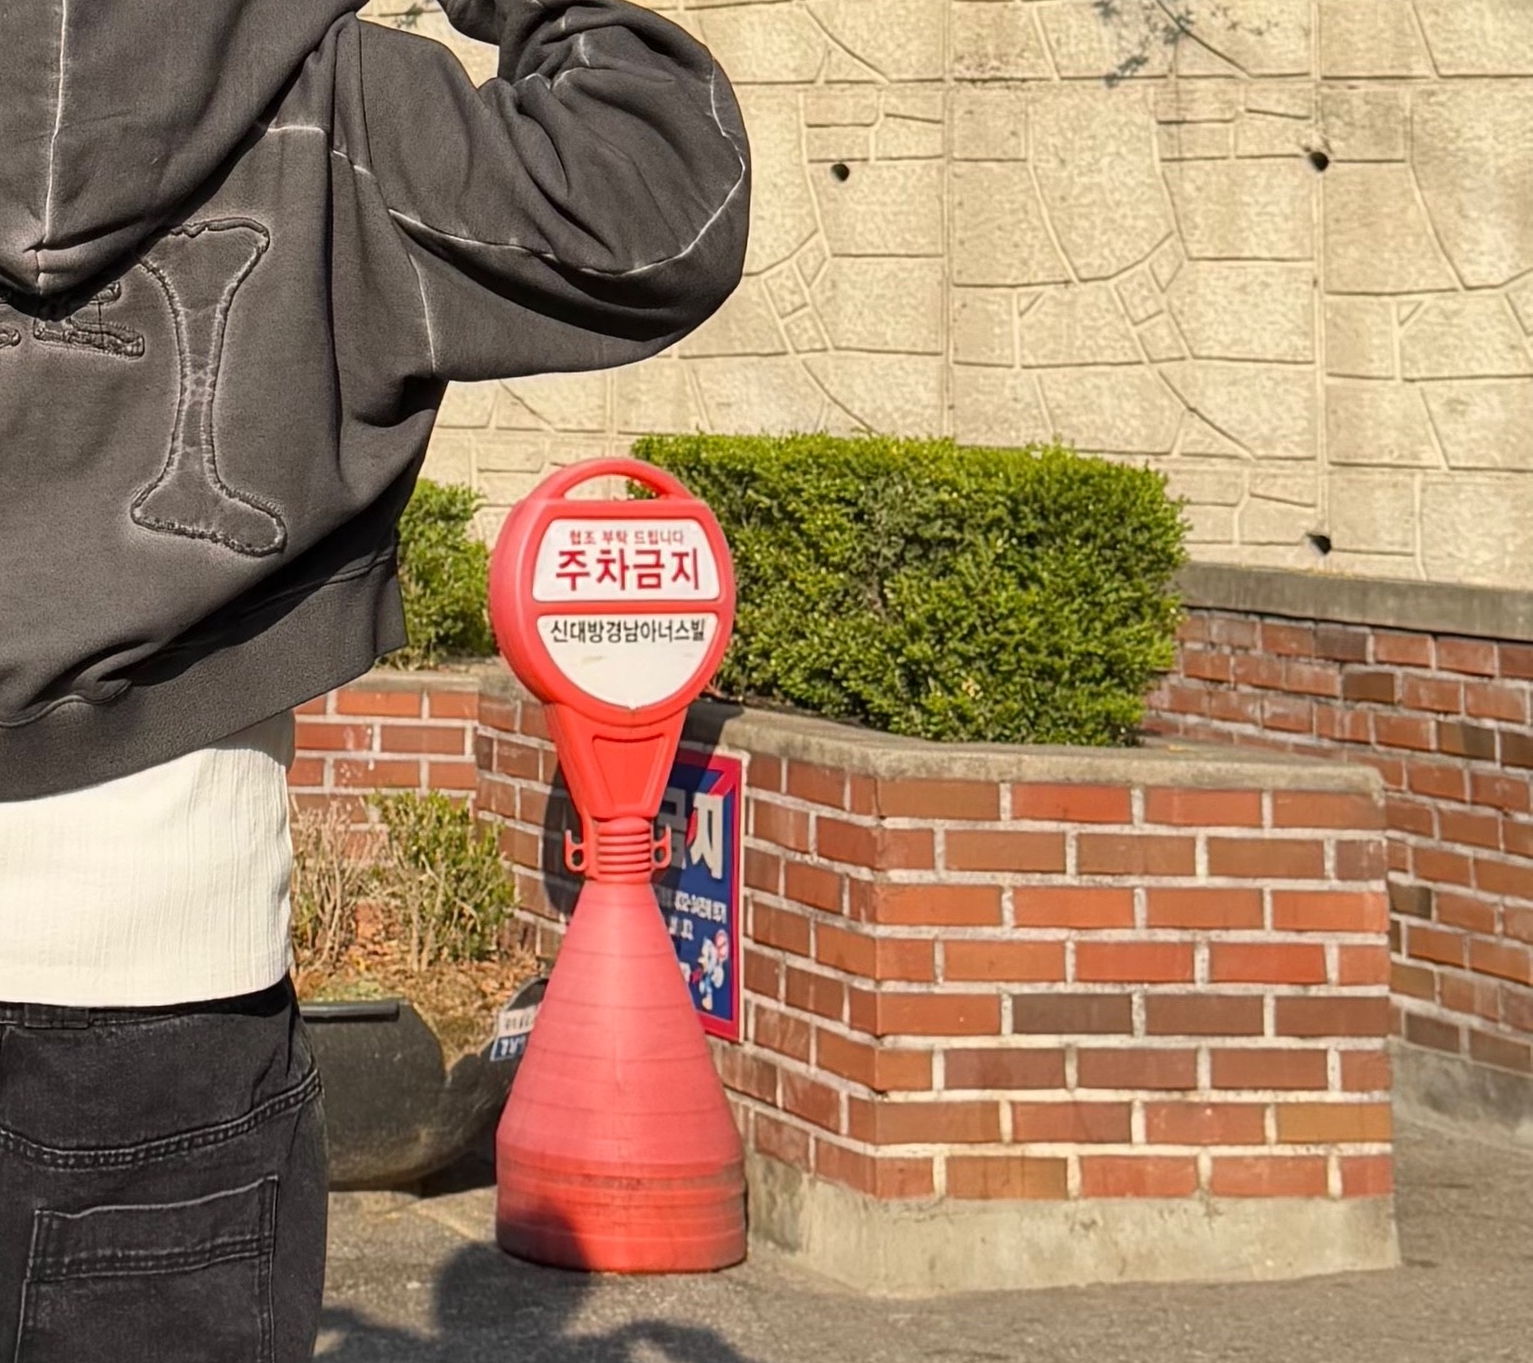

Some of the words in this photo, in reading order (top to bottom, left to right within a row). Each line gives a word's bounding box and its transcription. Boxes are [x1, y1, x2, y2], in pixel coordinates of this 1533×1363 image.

[570, 530, 597, 546] 협조
[602, 530, 629, 546] 부탁
[635, 529, 685, 546] 드립니다
[556, 547, 701, 592] 주차금지
[550, 619, 707, 645] 신대방경남아너스빌
